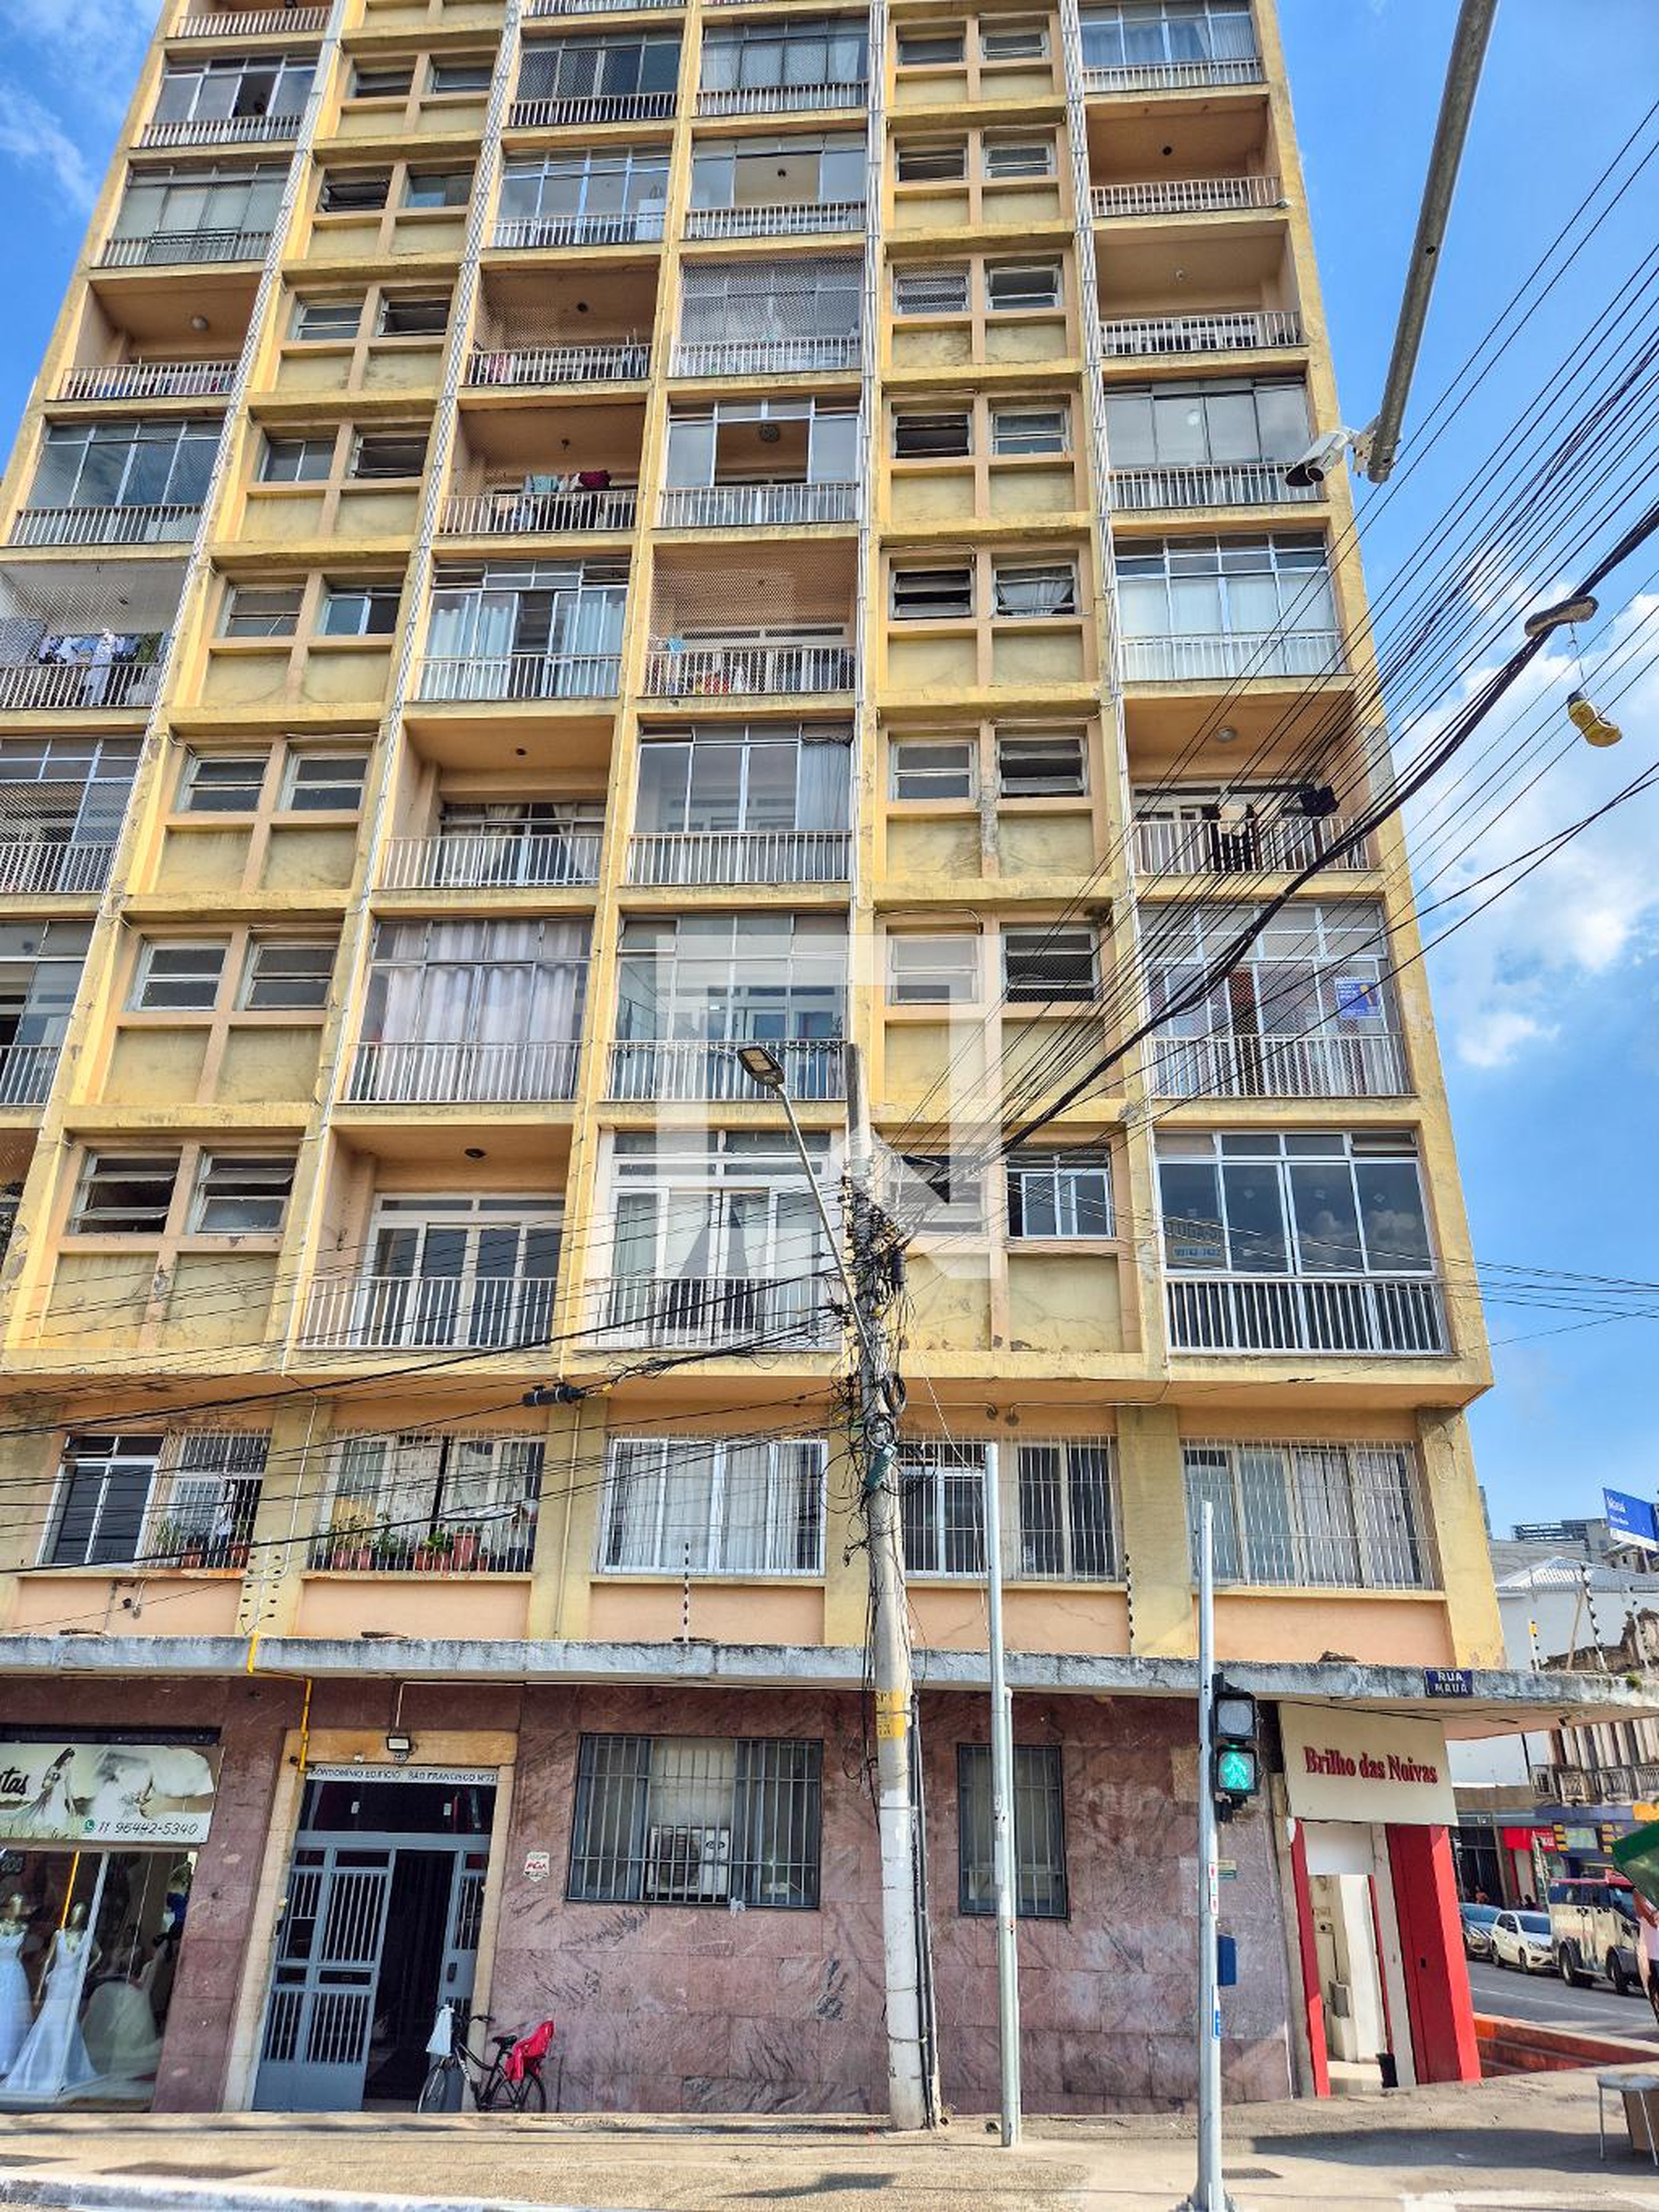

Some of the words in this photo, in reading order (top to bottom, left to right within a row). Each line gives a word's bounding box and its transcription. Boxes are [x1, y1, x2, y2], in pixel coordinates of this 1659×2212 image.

[1438, 1672, 1463, 1681] RUA
[1303, 1746, 1356, 1776] Brilho
[1360, 1752, 1386, 1779] das
[1387, 1754, 1438, 1783] Noivas
[0, 1766, 29, 1795] tas
[99, 1821, 111, 1833] 11
